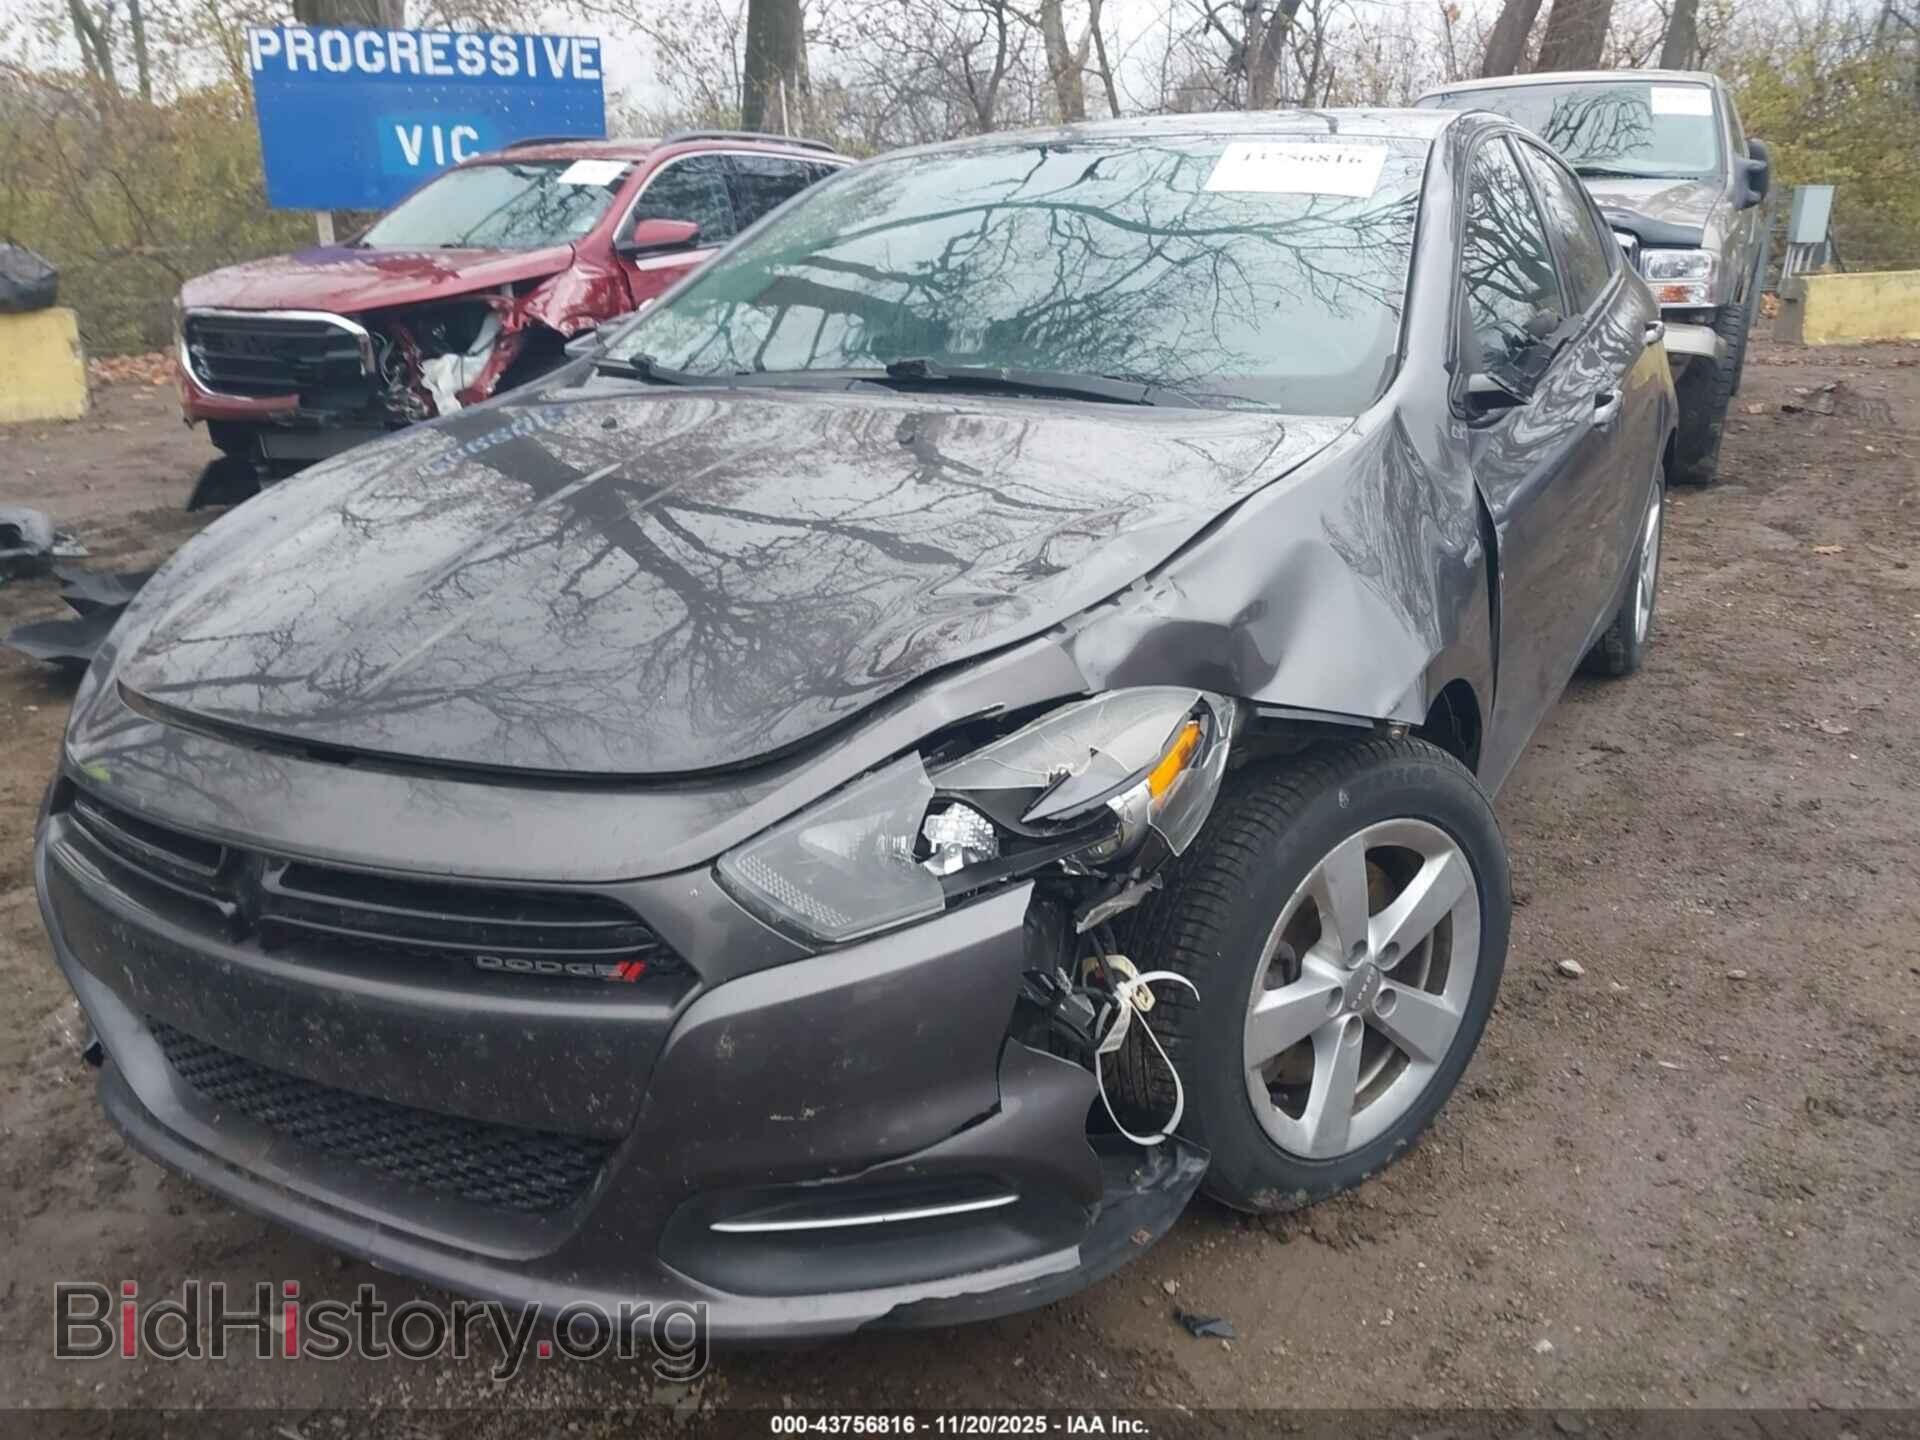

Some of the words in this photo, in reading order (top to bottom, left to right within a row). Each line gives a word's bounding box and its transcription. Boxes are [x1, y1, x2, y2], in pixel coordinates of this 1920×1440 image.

[251, 28, 601, 80] PROGRESSIVE
[395, 124, 480, 166] VIC
[475, 954, 624, 978] DODGE
